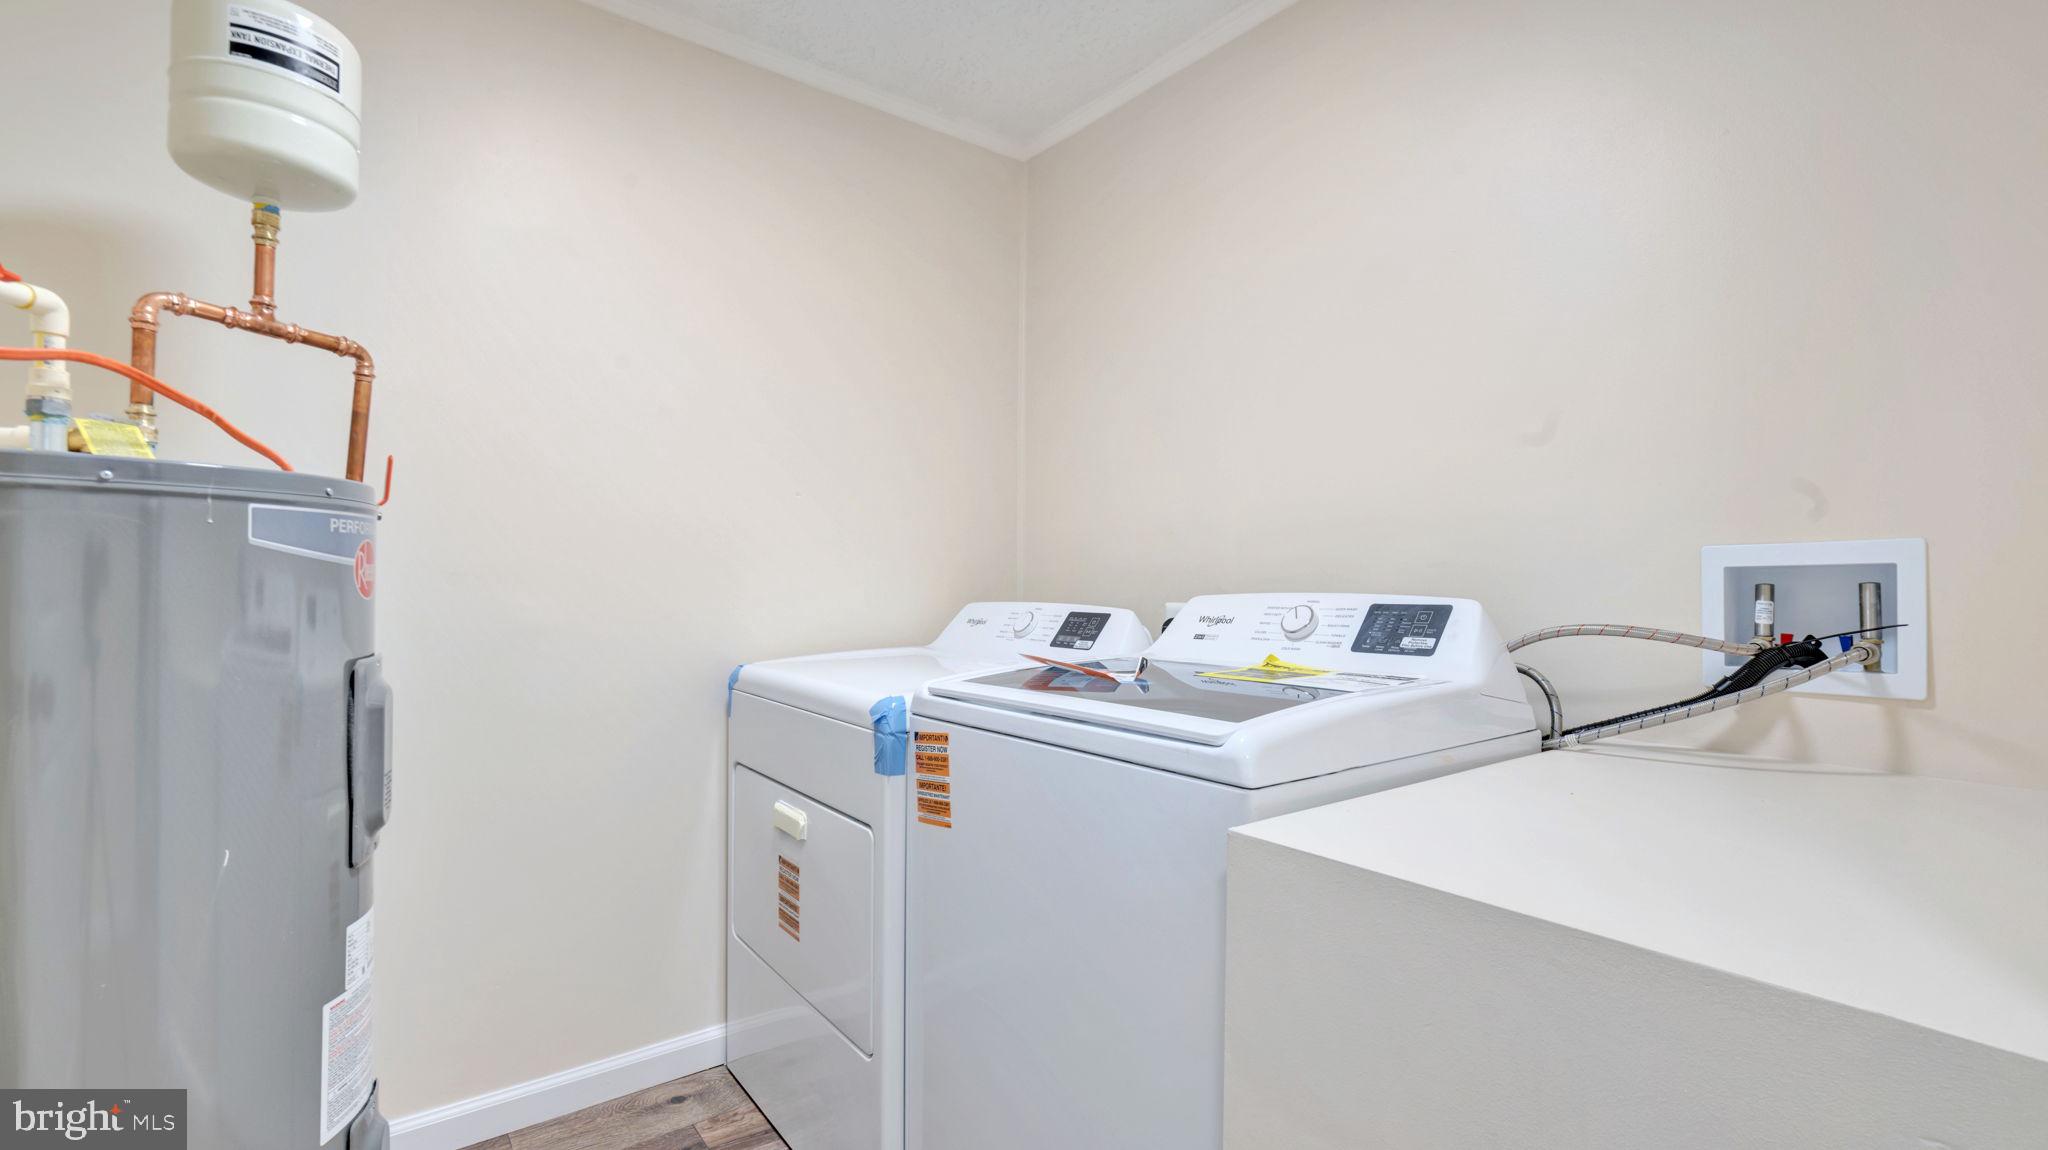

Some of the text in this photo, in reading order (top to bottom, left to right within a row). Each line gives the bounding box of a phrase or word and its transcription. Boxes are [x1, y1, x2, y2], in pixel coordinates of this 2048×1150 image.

[230, 29, 253, 43] TANK
[254, 35, 302, 59] EXPANSION
[1198, 614, 1235, 627] Whirlpool
[915, 744, 948, 754] REGISTER NOW
